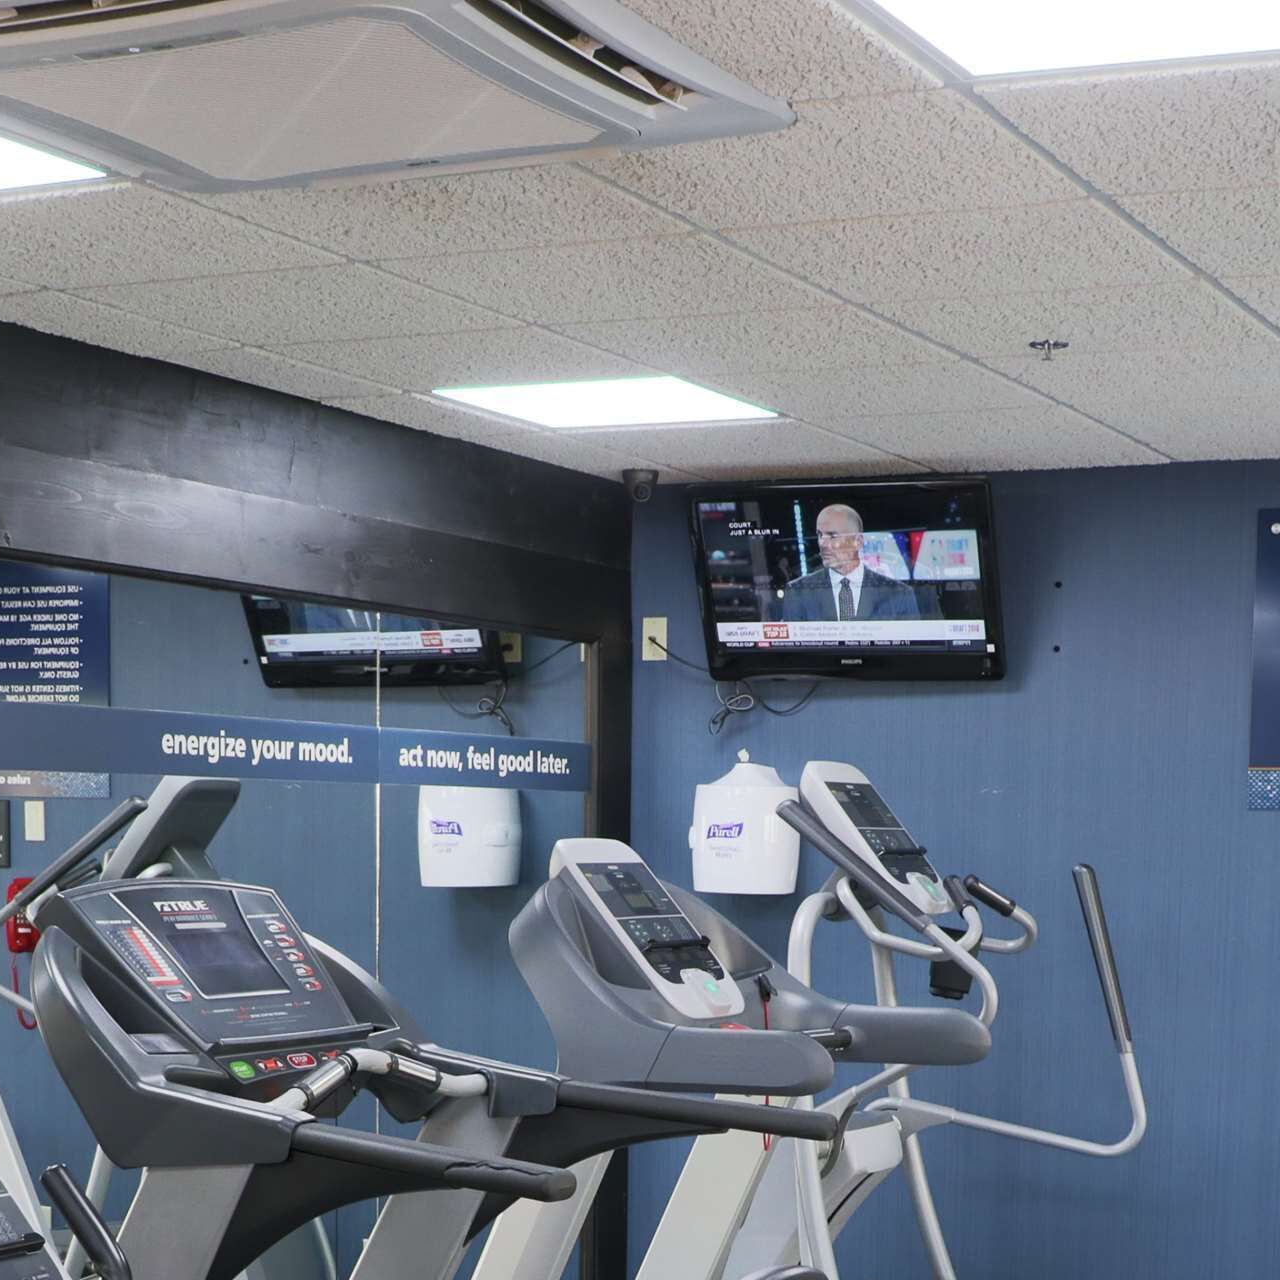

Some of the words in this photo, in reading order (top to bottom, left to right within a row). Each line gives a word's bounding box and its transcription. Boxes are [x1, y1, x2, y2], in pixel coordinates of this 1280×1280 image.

[161, 730, 247, 763] energize
[251, 738, 294, 765] your
[298, 738, 353, 764] mood.
[398, 746, 424, 767] act
[426, 749, 463, 771] now,
[466, 746, 495, 770] feel
[498, 751, 534, 776] good
[537, 751, 570, 775] later.
[172, 899, 210, 912] TRUE
